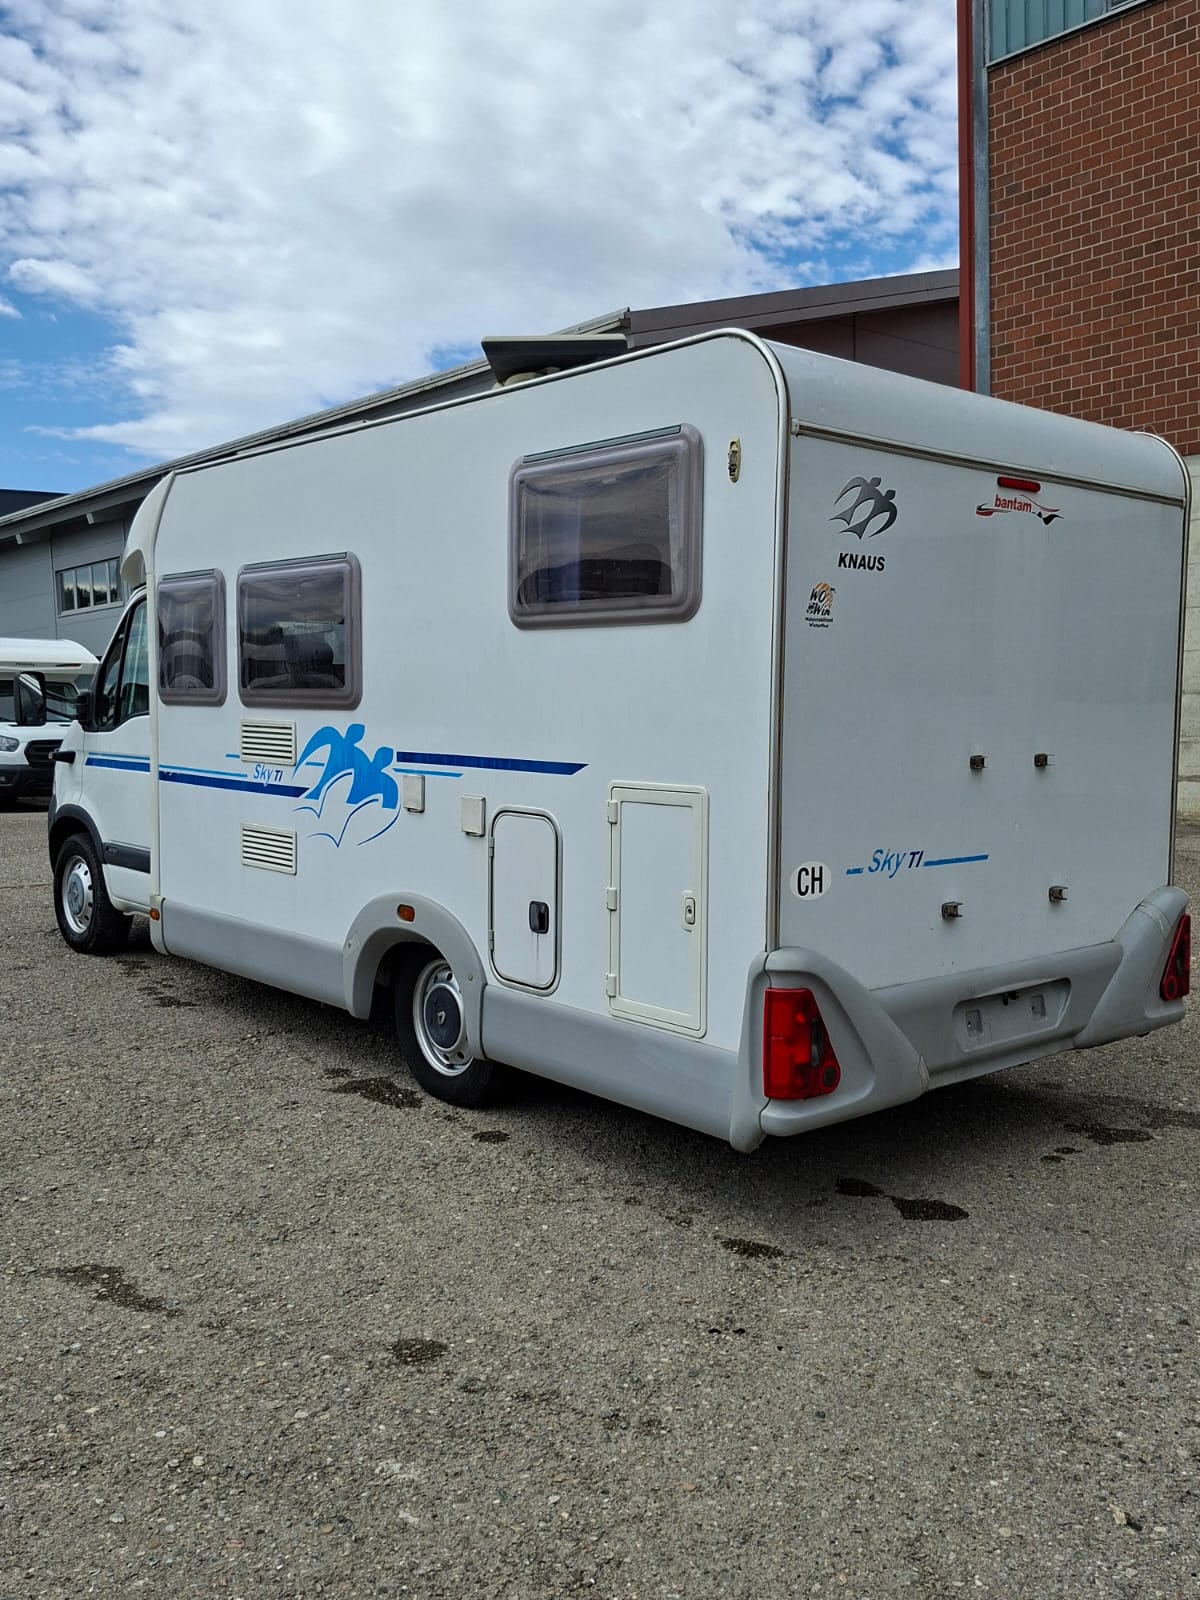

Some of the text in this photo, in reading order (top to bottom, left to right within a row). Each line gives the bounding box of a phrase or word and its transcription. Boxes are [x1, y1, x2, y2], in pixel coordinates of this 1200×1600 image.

[995, 494, 1032, 512] bantam
[838, 552, 886, 572] KNAUS
[253, 763, 273, 787] Sky
[868, 849, 924, 879] Sky TI
[797, 865, 823, 896] CH
